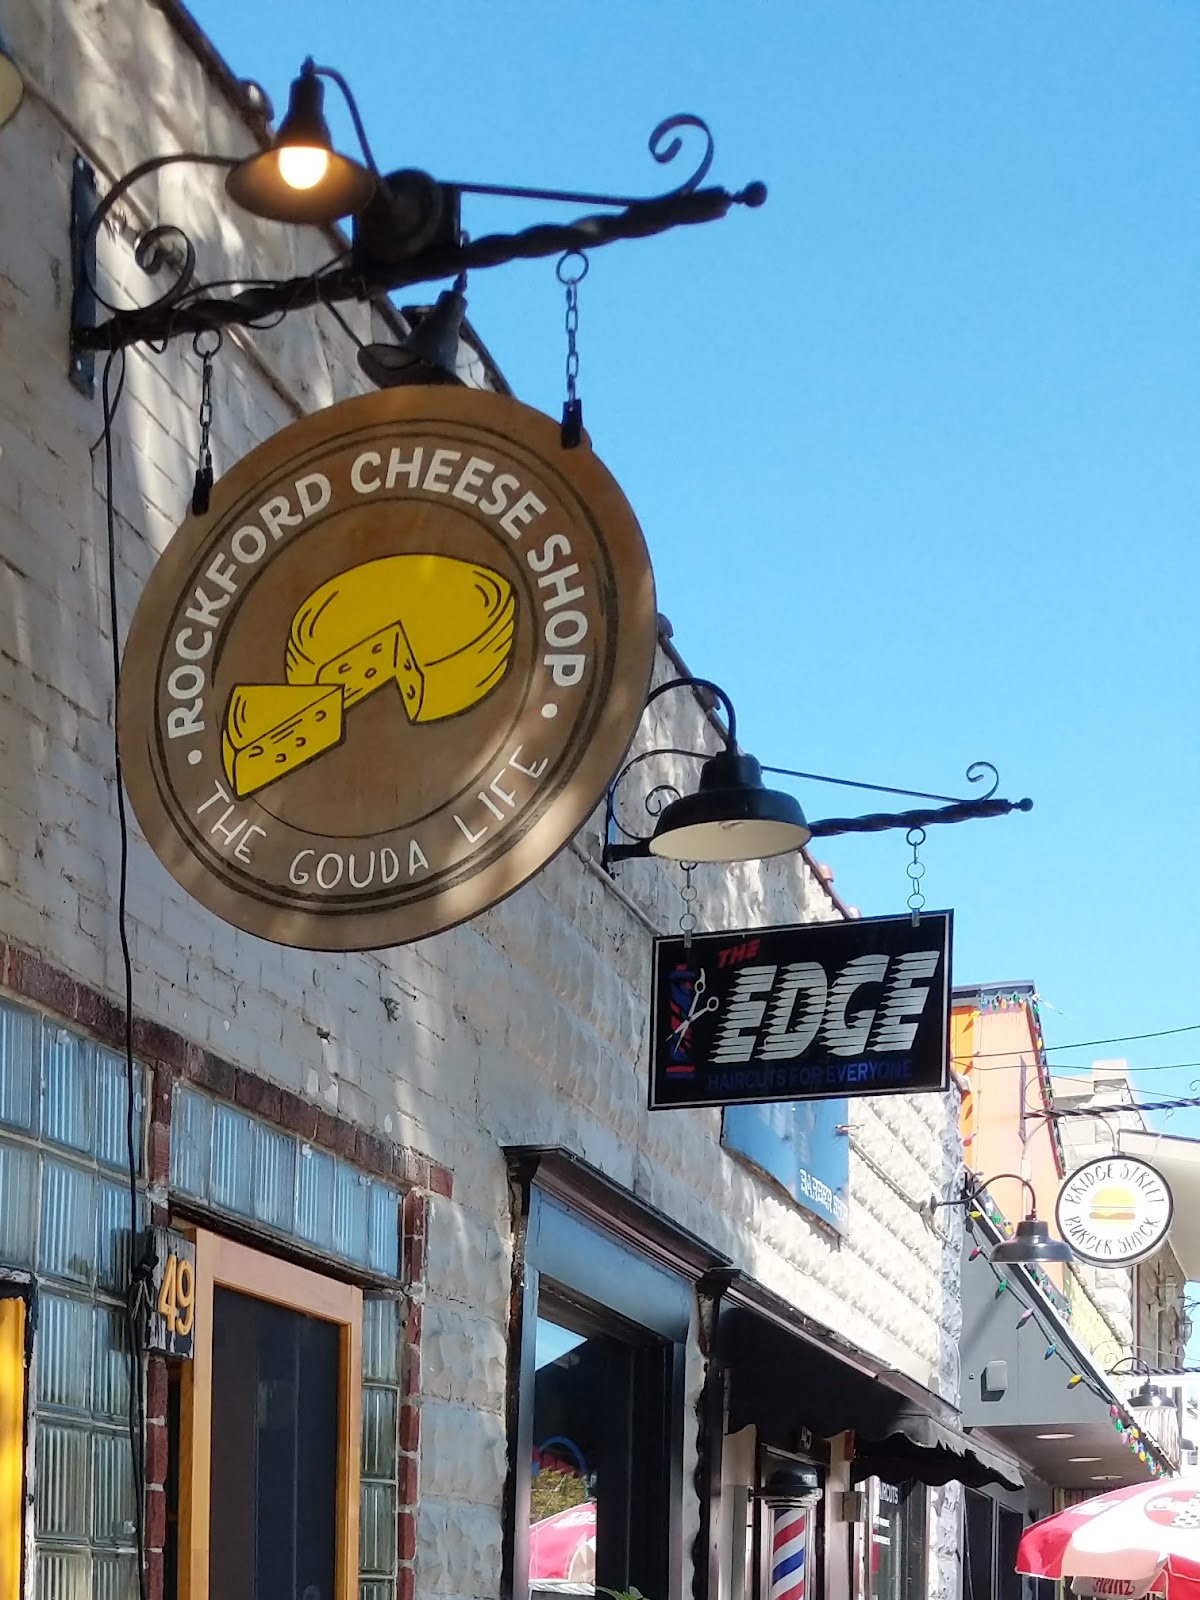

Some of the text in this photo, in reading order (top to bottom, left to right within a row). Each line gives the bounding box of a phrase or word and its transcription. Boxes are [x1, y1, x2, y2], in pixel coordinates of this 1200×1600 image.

[167, 446, 589, 739] ROCKFORD CHEESE SHOP
[196, 744, 550, 889] THE GOUDA LIFE
[718, 939, 761, 968] THE
[707, 950, 940, 1064] EDGE
[708, 1066, 786, 1090] HAIRCUTS
[827, 1060, 913, 1082] EVERYONE
[800, 1168, 833, 1213] BARBER
[1064, 1162, 1165, 1205] BRIDGE STREET
[1064, 1215, 1161, 1255] BURGER SHACK
[158, 1253, 194, 1336] 49
